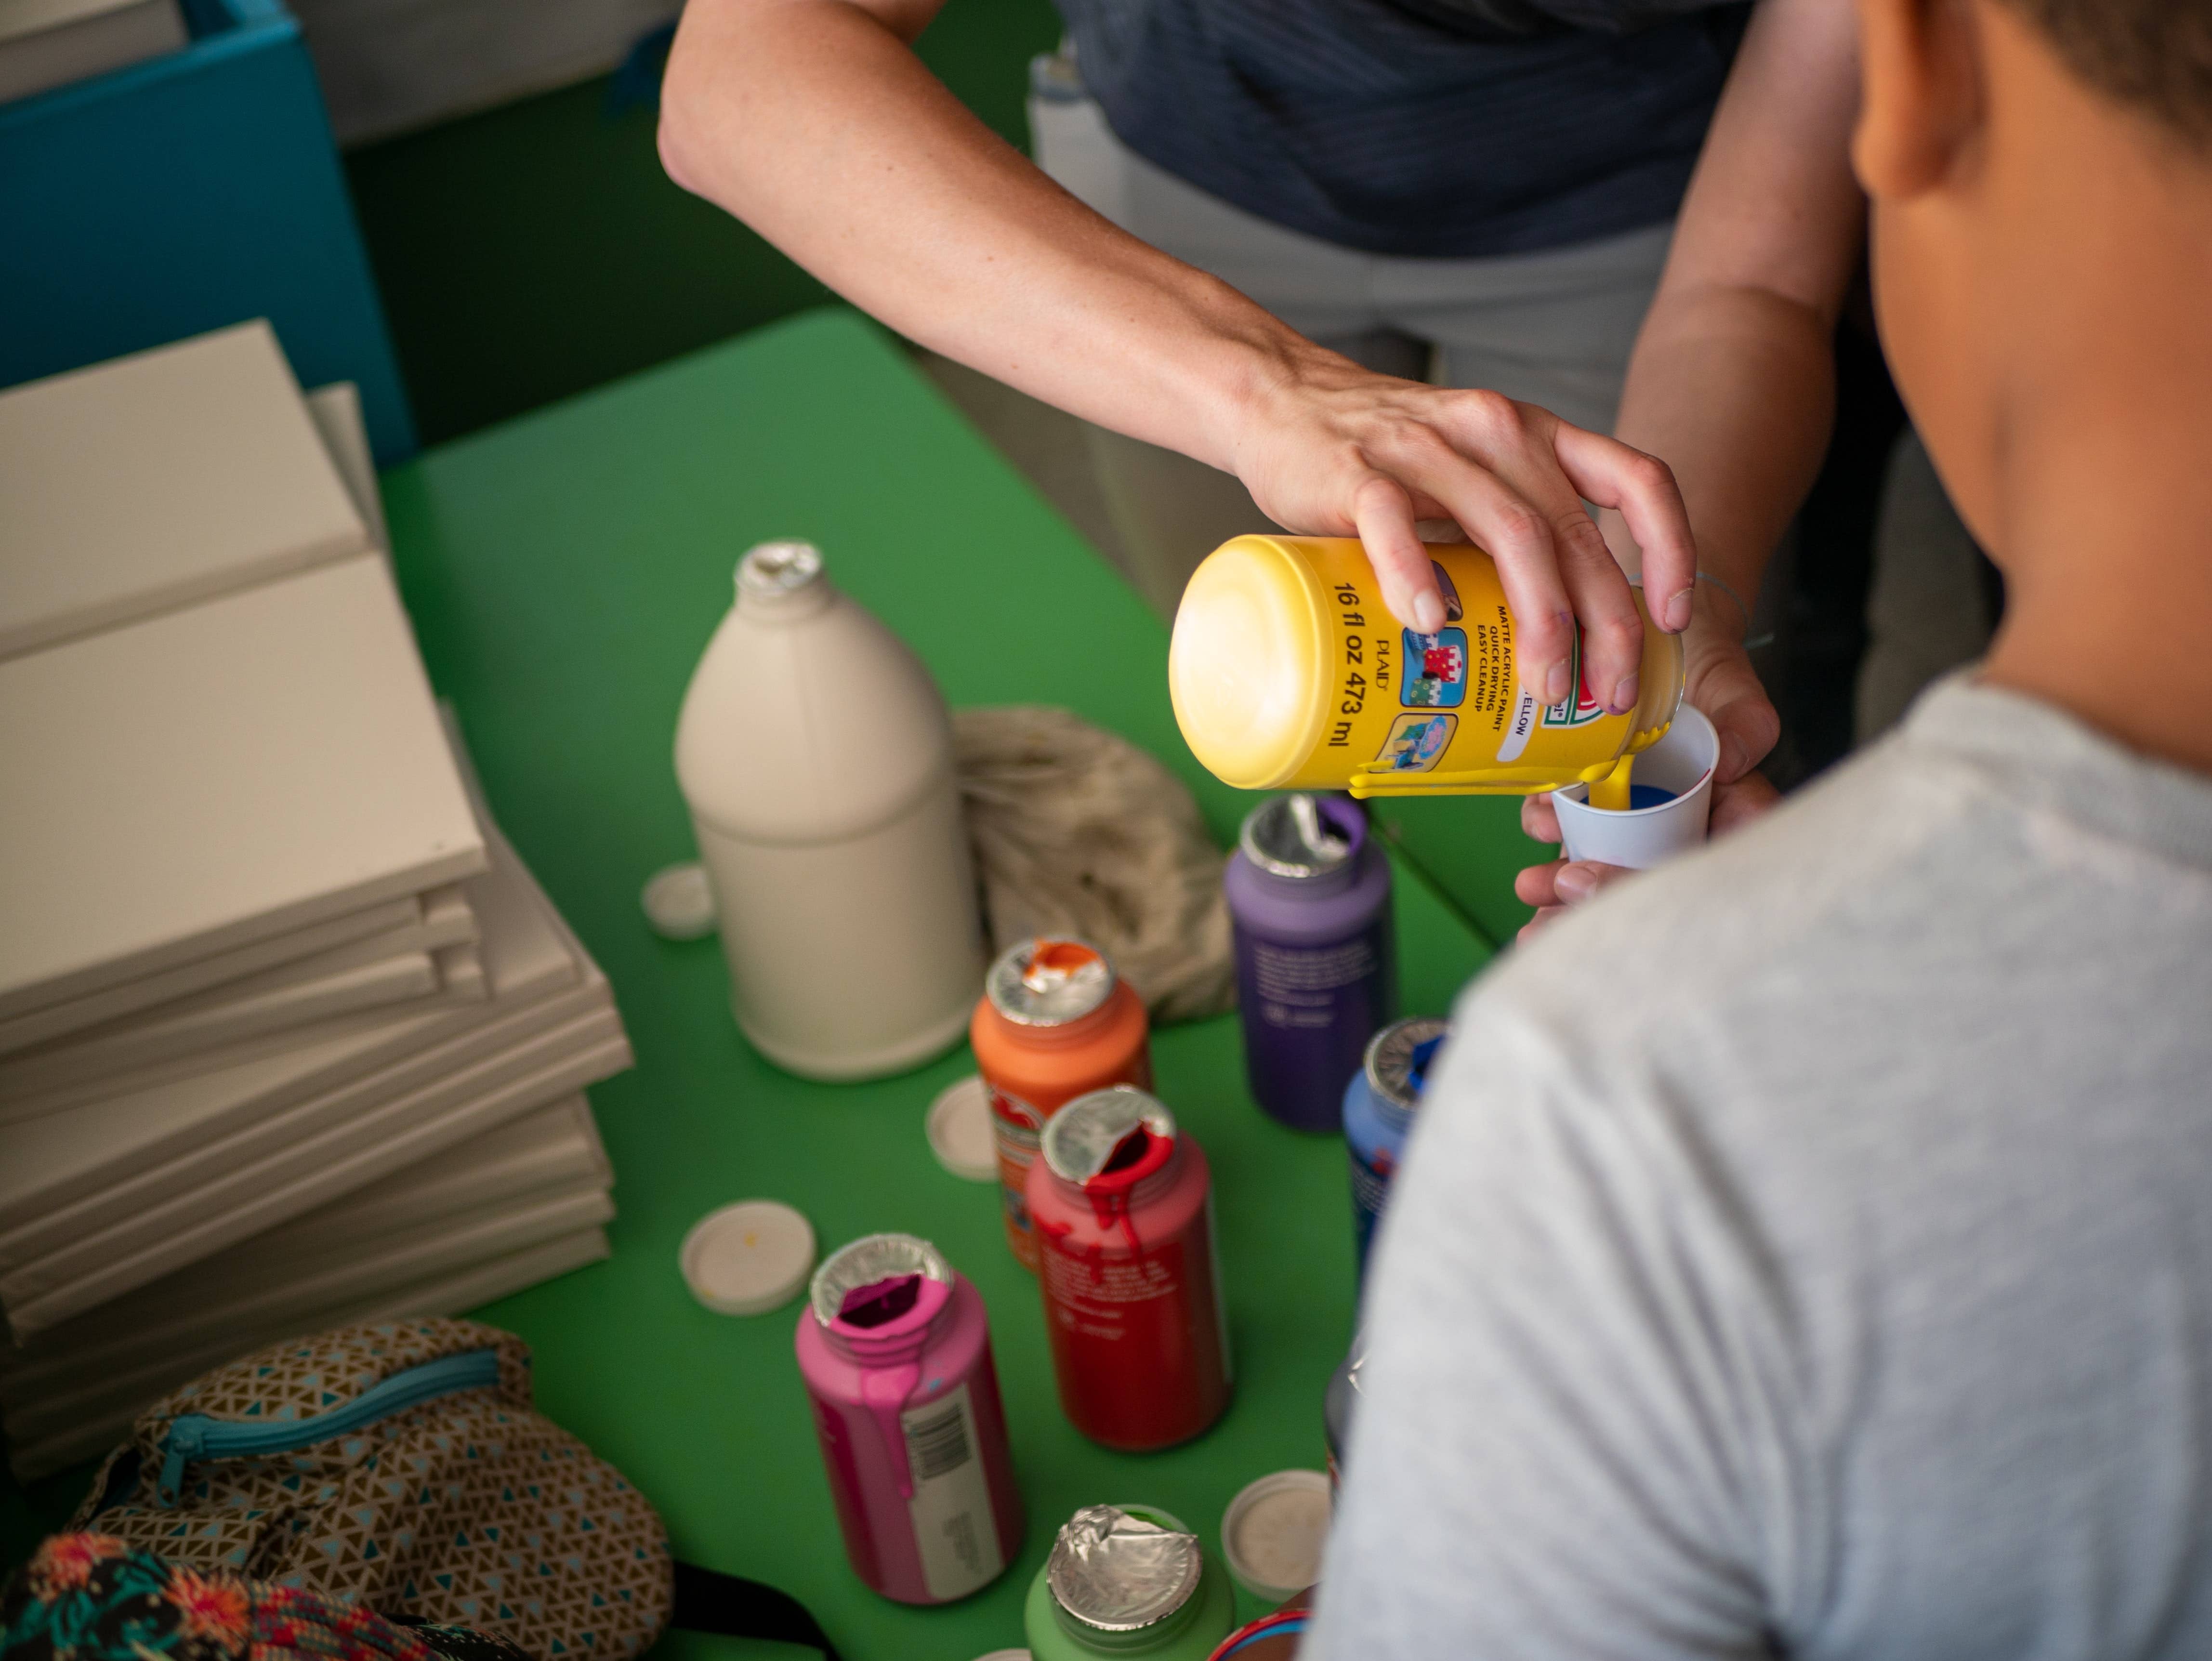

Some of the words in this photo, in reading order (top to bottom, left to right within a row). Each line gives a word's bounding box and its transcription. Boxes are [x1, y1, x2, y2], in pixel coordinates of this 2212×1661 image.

[1334, 582, 1360, 606] 16
[1343, 612, 1366, 627] fl
[1497, 606, 1511, 645] MATTE
[1346, 635, 1363, 665] oz
[1477, 625, 1488, 655] EASY
[1490, 626, 1499, 663] QUICK
[1376, 640, 1390, 688] PLAID
[1501, 647, 1511, 696] ACRYLIC
[1341, 672, 1367, 715] 473
[1475, 657, 1488, 712] CLEANUP
[1487, 667, 1499, 711] DRYING
[1492, 699, 1507, 732] PAINT
[1515, 691, 1533, 736] ELLOW
[1328, 722, 1352, 746] ml
